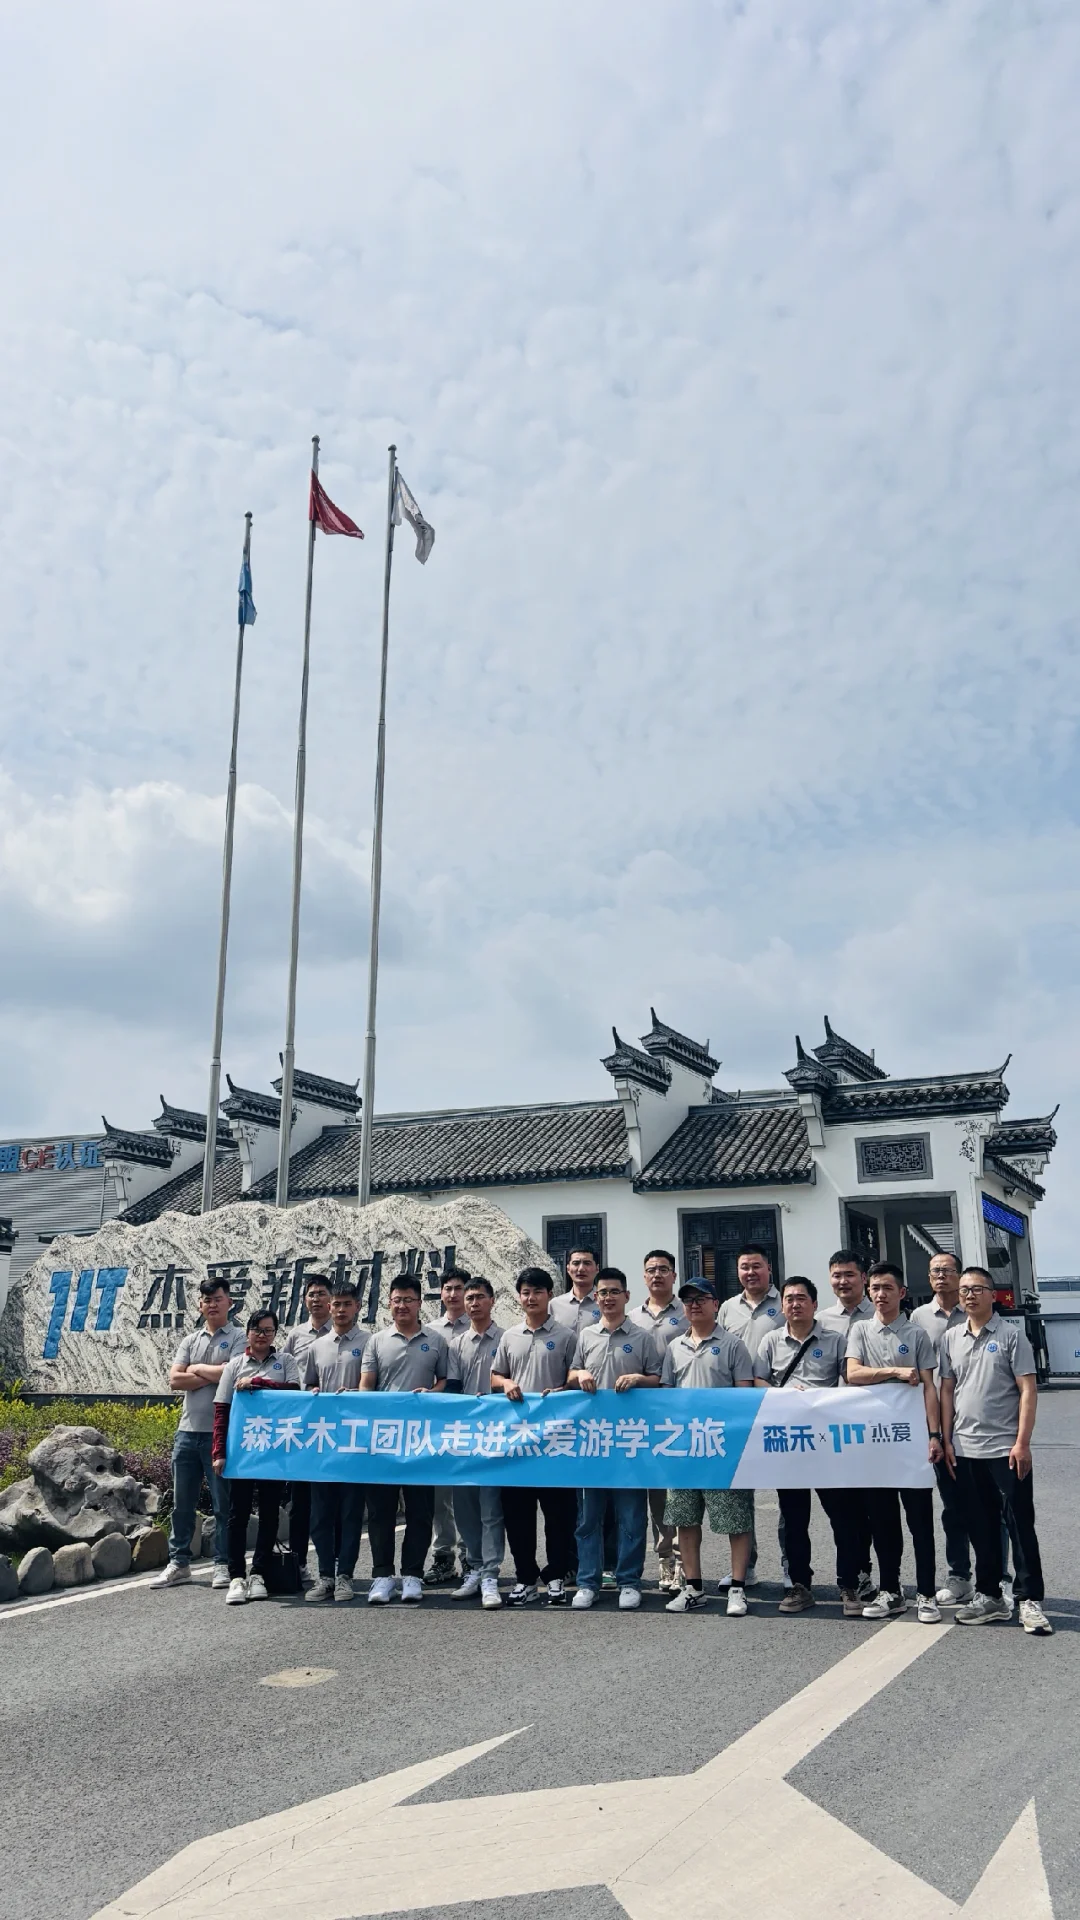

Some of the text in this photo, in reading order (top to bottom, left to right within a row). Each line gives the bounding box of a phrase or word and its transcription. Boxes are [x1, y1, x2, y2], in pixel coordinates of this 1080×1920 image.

[240, 1415, 726, 1459] 森禾木工团队走进杰爱游学之旅
[763, 1425, 816, 1453] 森禾
[870, 1422, 912, 1443] 杰爱
